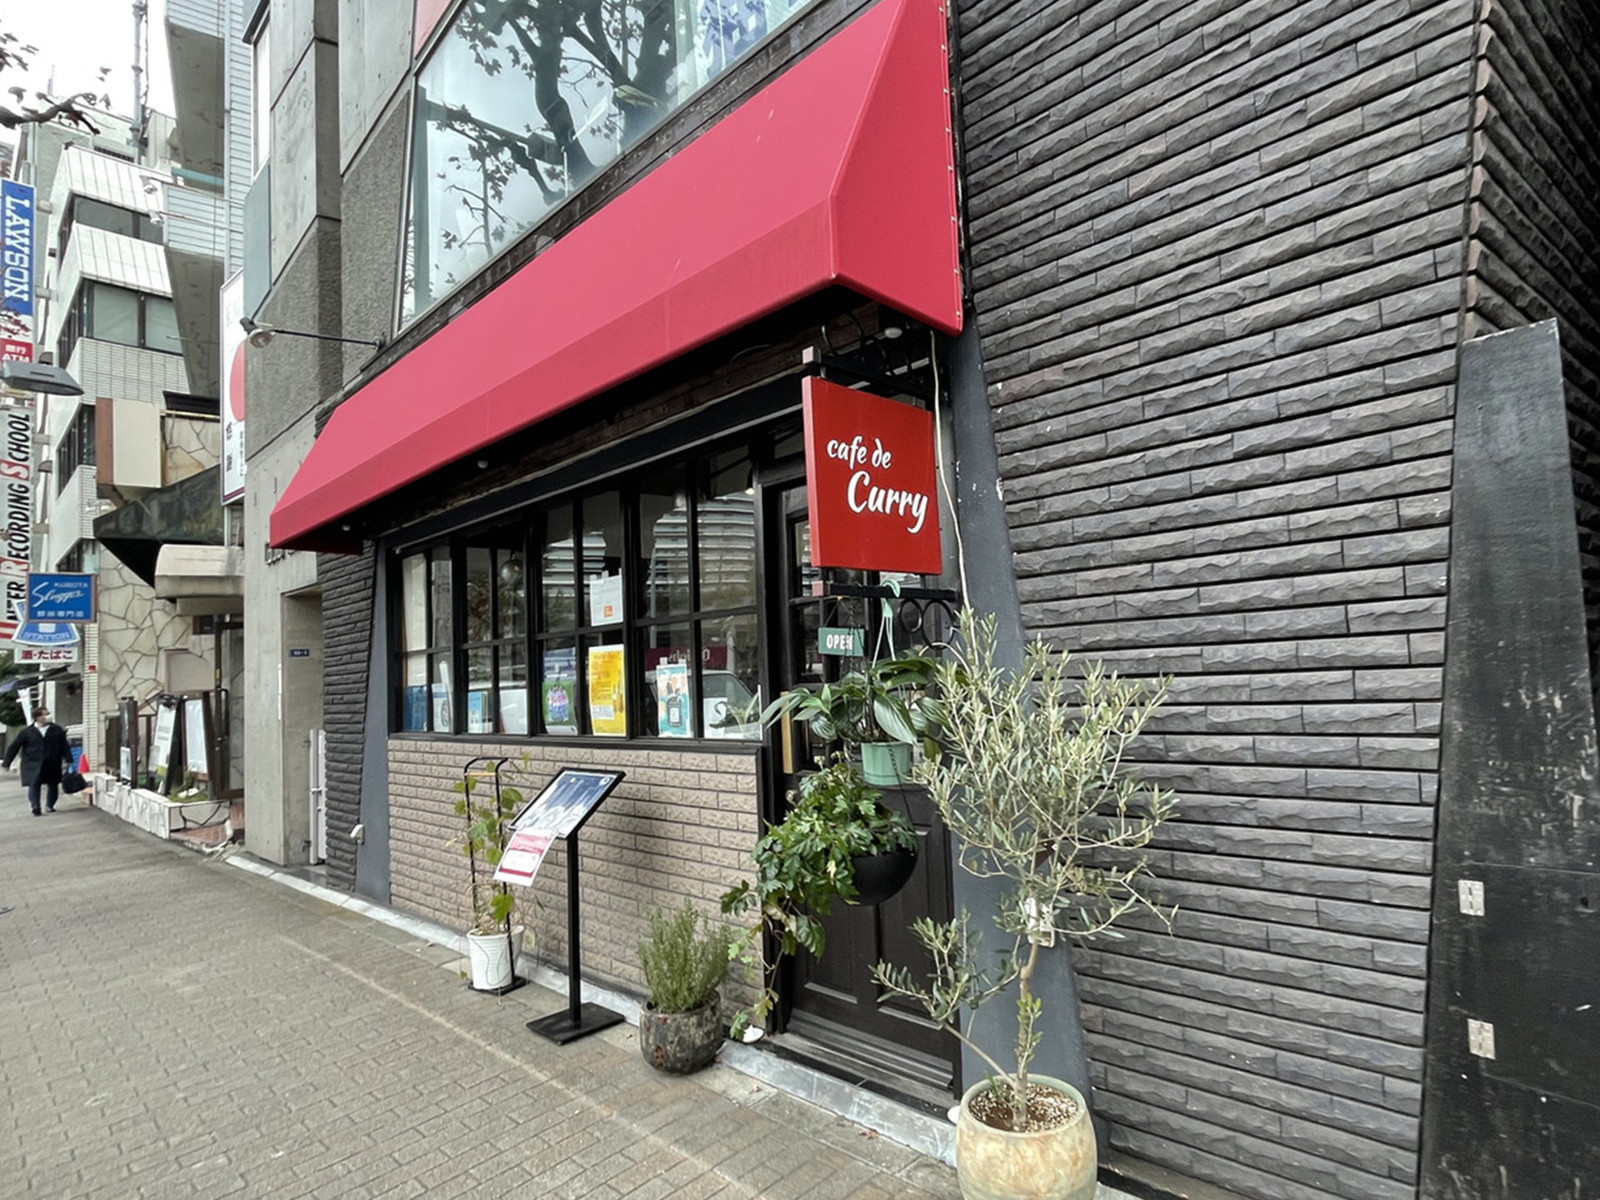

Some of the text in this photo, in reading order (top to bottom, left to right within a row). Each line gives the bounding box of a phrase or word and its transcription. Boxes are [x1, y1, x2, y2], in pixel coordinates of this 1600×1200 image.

[4, 196, 30, 302] LAWSON
[2, 353, 30, 363] ATM
[0, 413, 30, 481] SCHOOL
[826, 435, 892, 471] cafe de
[846, 470, 930, 535] Curry
[0, 482, 30, 577] RECORDING
[23, 631, 70, 642] STATION
[826, 634, 854, 650] OPEN
